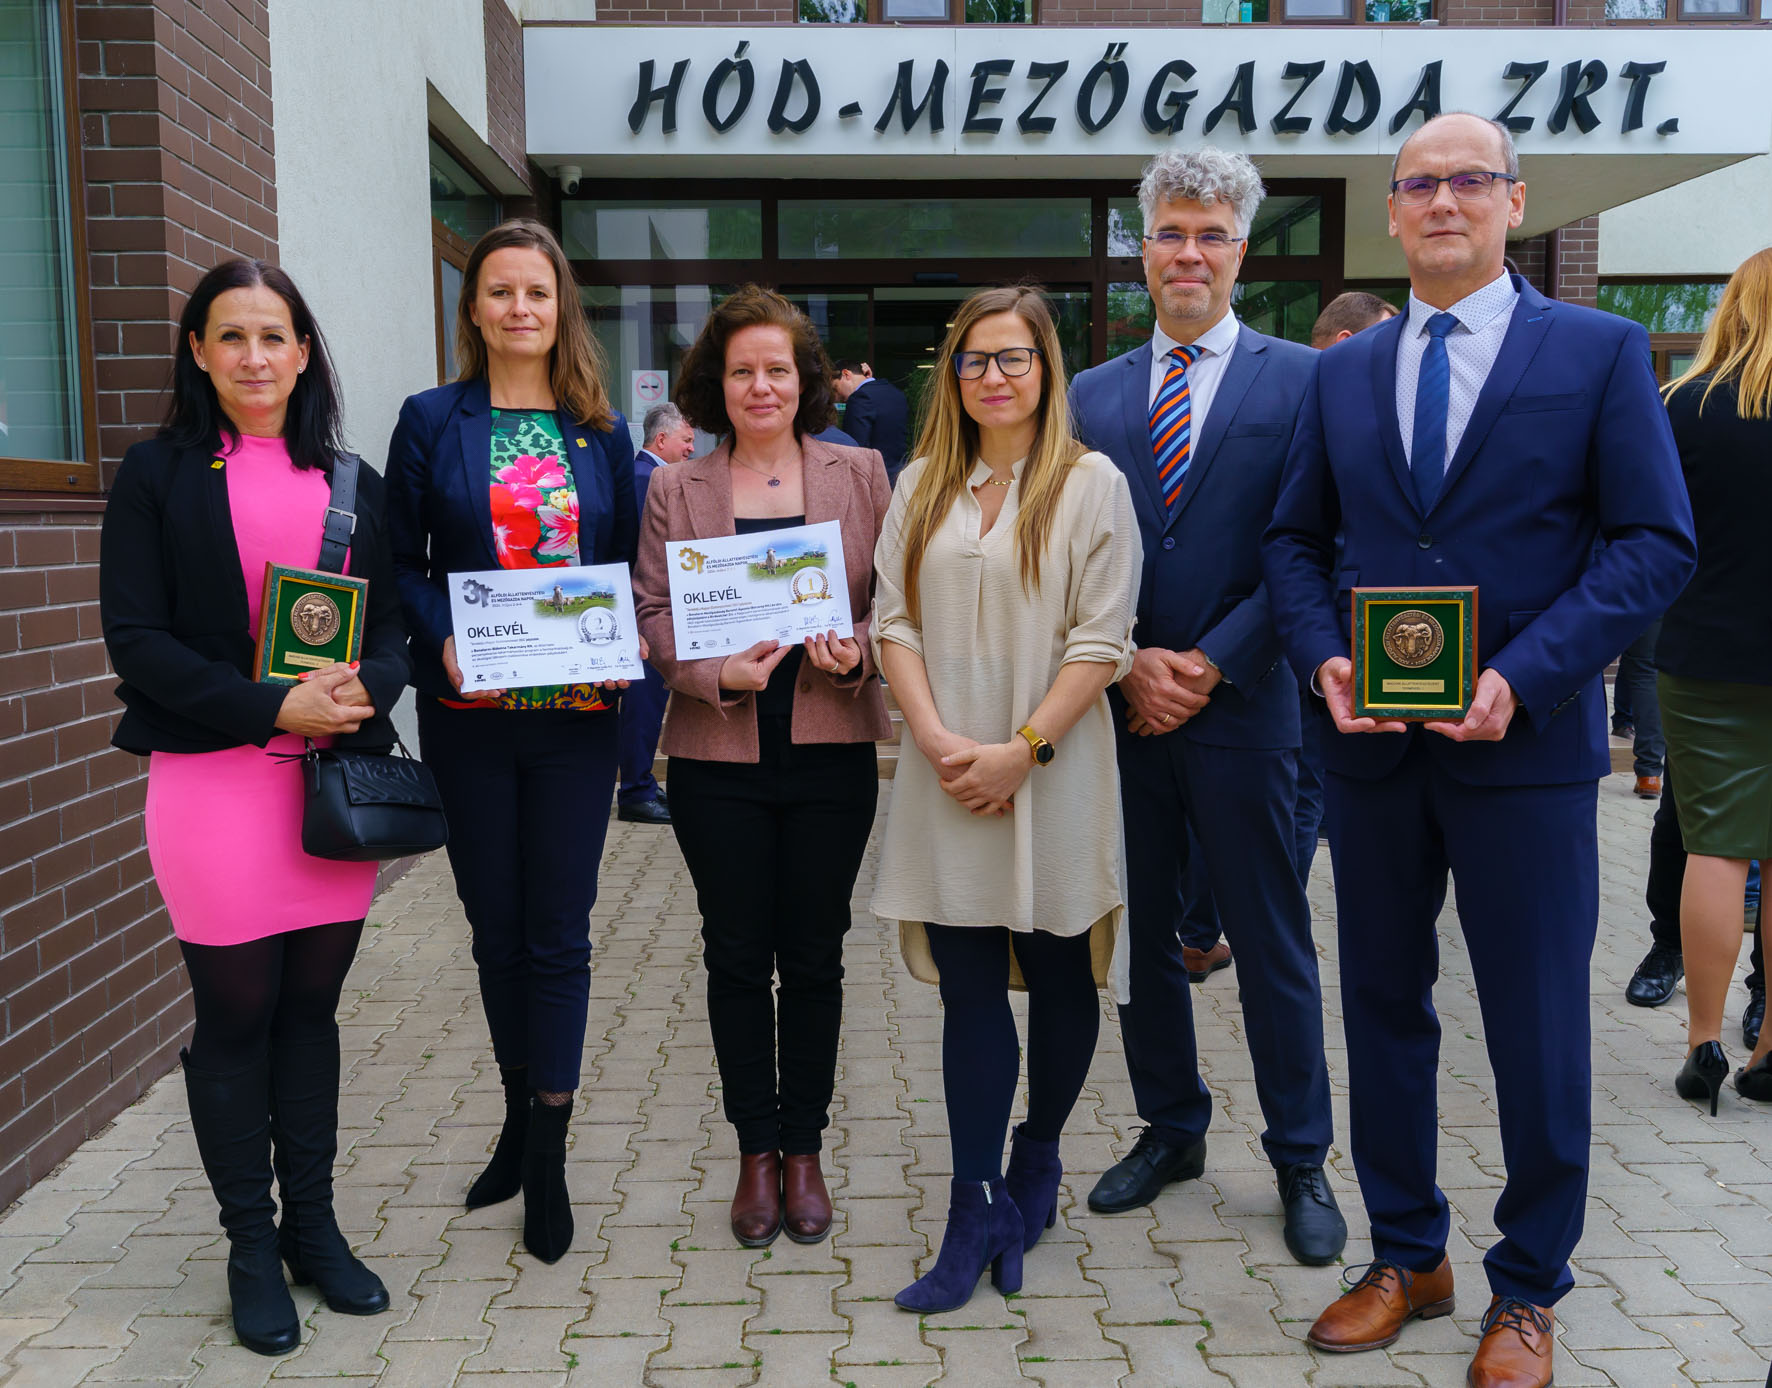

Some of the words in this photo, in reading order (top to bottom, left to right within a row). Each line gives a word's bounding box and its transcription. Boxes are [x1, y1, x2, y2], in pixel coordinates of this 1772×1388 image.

[1493, 58, 1680, 136] ZRT.
[808, 578, 813, 590] 1
[684, 586, 742, 604] OKLEVÉL
[467, 621, 528, 638] OKLEVÉL
